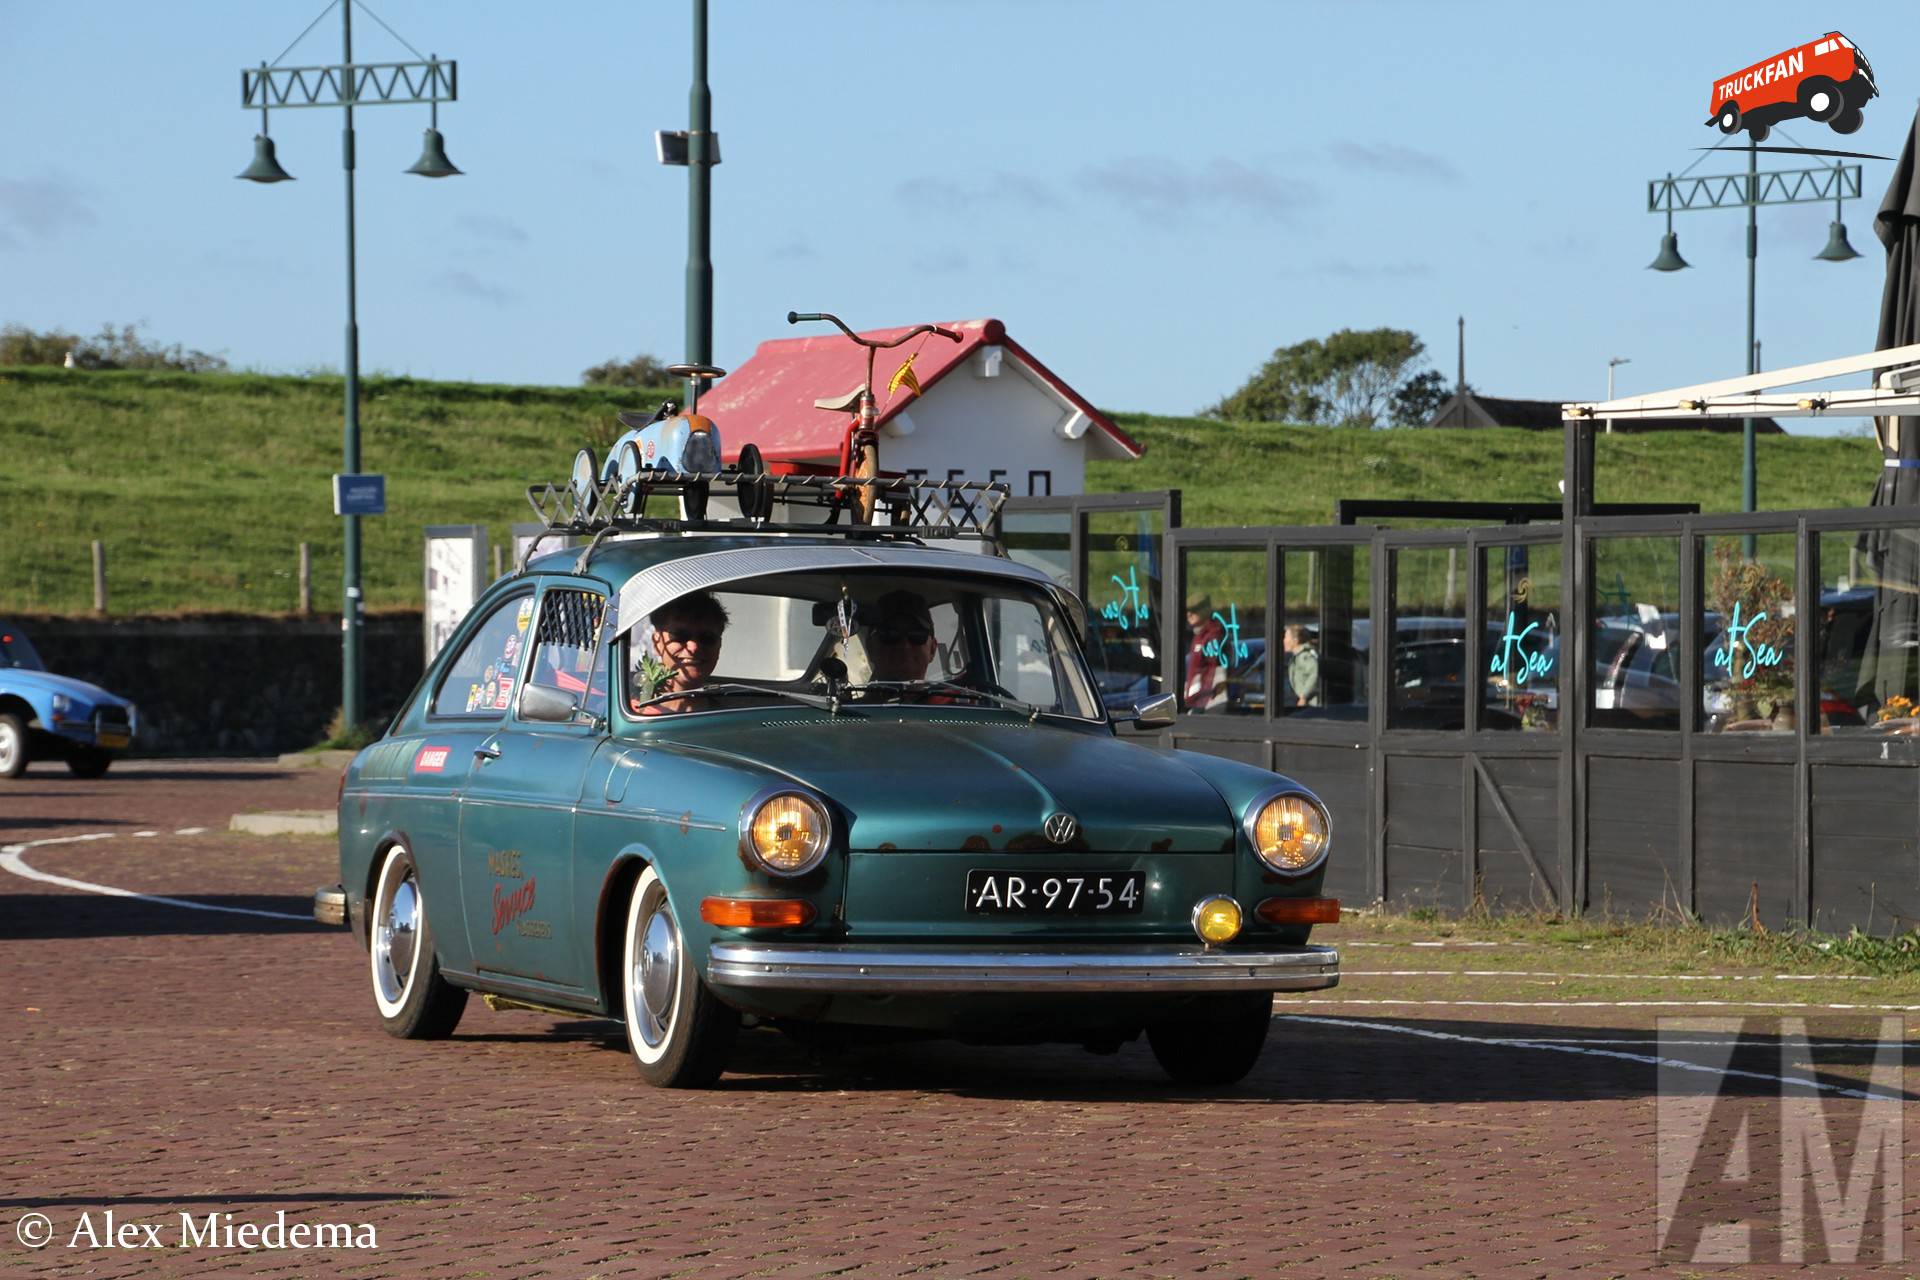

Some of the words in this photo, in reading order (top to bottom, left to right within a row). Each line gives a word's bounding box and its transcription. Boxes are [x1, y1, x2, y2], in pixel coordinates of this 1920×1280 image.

[1491, 610, 1520, 682] at
[1516, 622, 1554, 685] Sea
[1714, 600, 1746, 678] at
[1743, 611, 1783, 680] Sea
